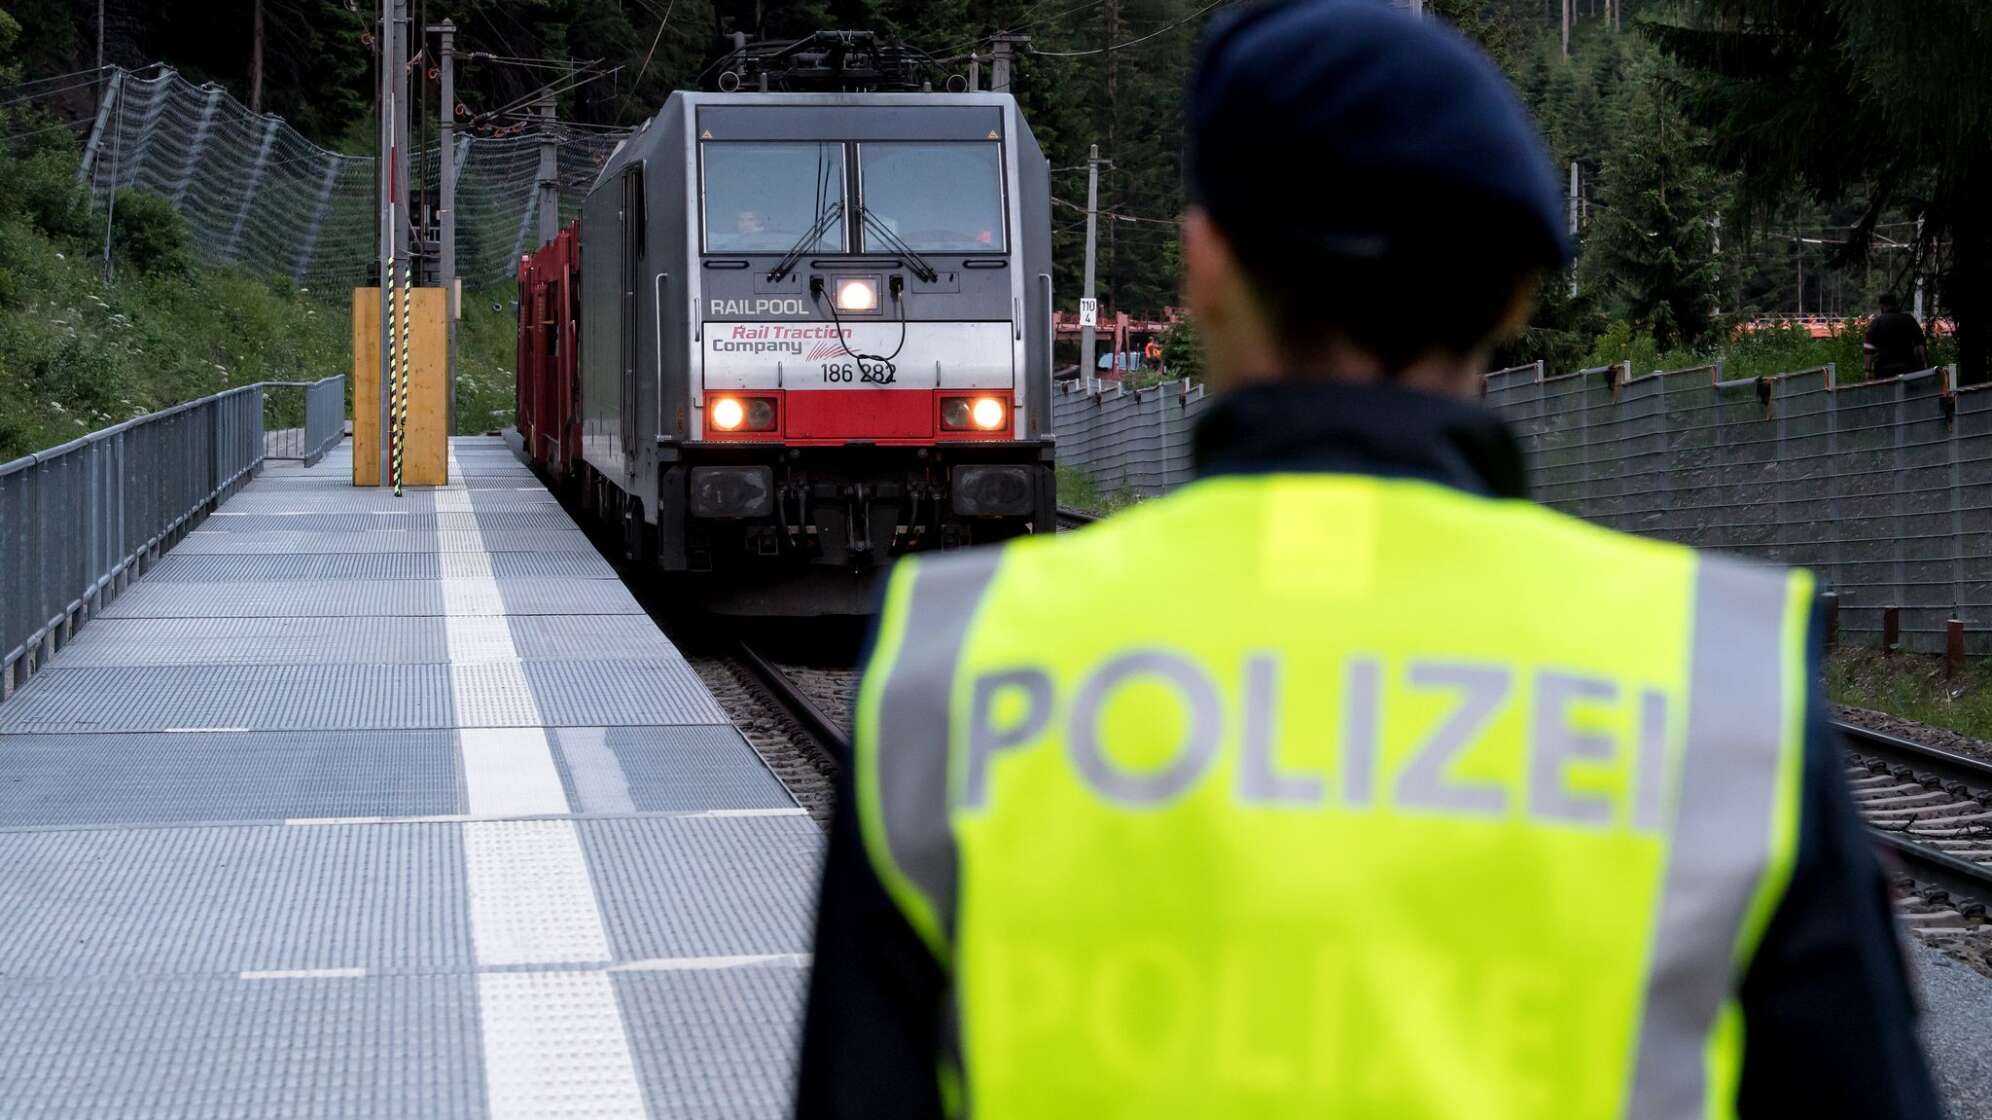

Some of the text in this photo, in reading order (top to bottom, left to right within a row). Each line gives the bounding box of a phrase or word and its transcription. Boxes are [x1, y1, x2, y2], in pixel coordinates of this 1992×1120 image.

[710, 299, 810, 315] RAILPOOL
[1081, 301, 1095, 312] 110
[1085, 313, 1091, 323] 4
[731, 325, 852, 339] Rail Traction
[712, 339, 803, 355] Company
[821, 363, 896, 384] 186 282
[961, 647, 1668, 837] POLIZEI
